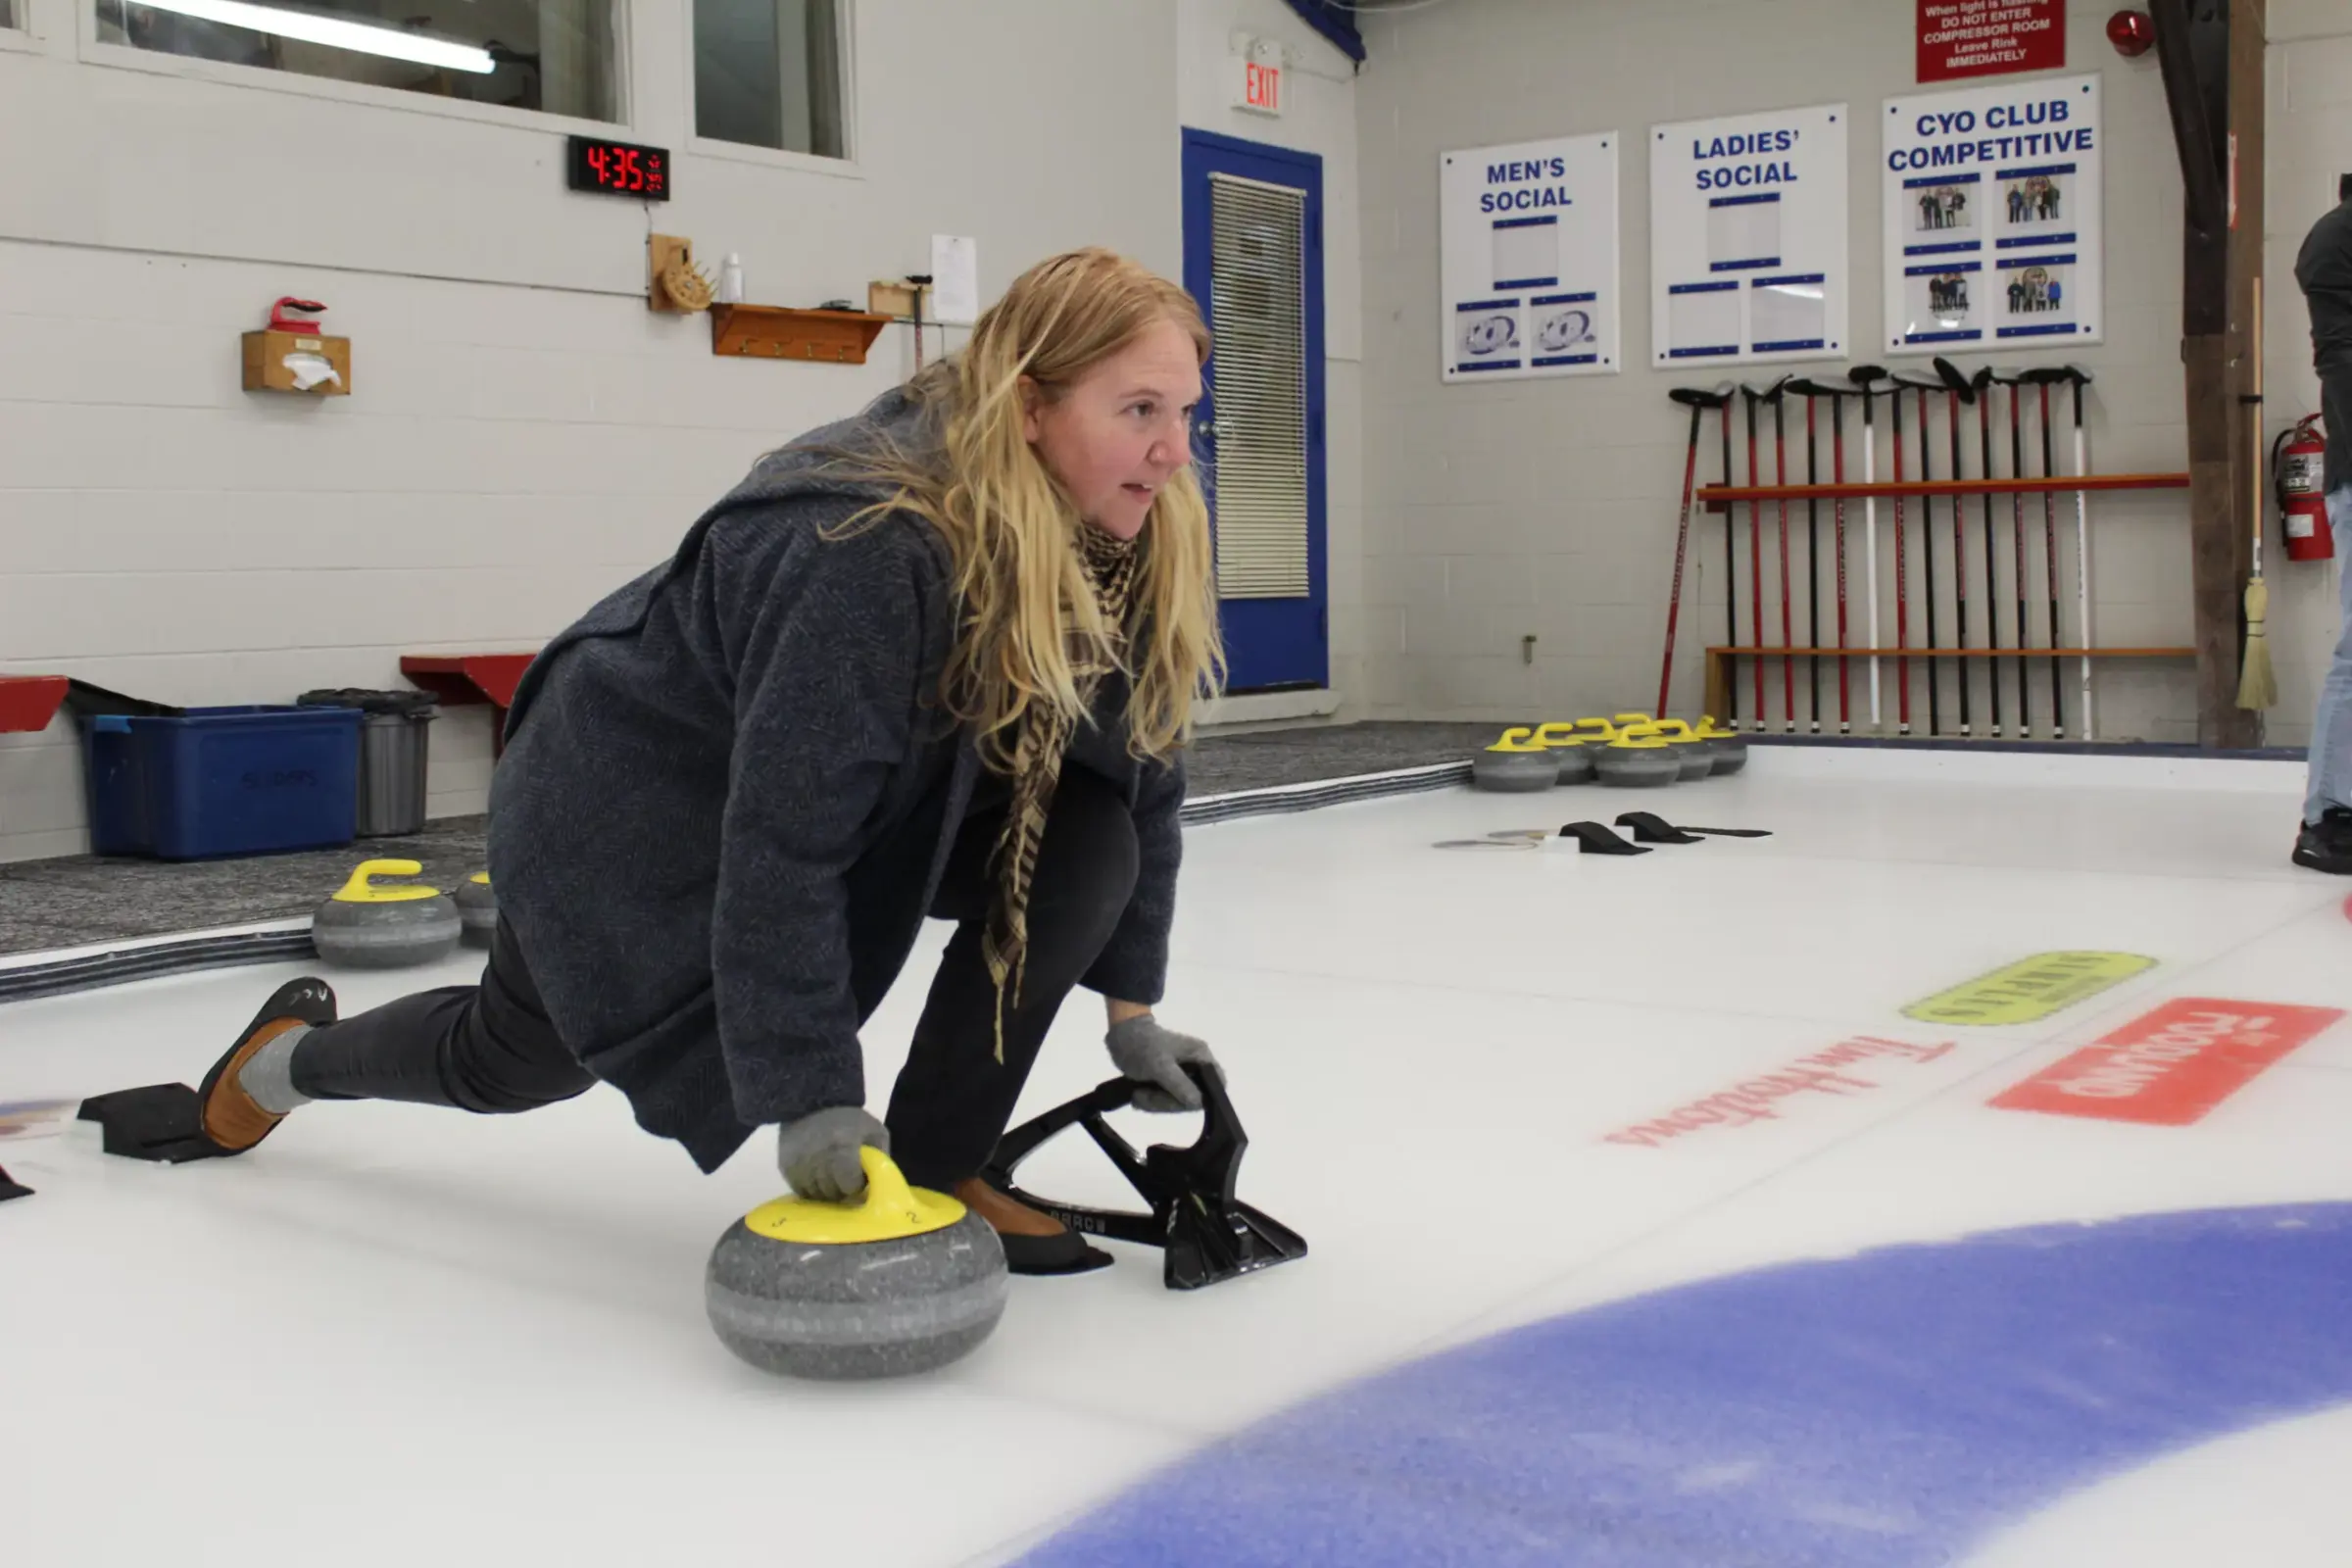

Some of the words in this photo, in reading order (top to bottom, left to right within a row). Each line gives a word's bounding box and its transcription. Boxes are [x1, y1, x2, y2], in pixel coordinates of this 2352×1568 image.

[1926, 6, 1957, 17] When
[1960, 1, 1985, 14] light
[1941, 16, 1959, 28] DO
[1962, 13, 1986, 25] NOT
[1989, 7, 2031, 22] ENTER
[1924, 24, 2008, 44] COMPRESSOR
[2012, 19, 2050, 33] ROOM
[1946, 48, 2027, 69] IMMEDIATELY
[1954, 42, 1987, 54] Leave
[1991, 37, 2017, 49] Rink
[1247, 62, 1278, 109] EXIT
[1917, 110, 1976, 137] CYO
[1985, 100, 2069, 129] CLUB
[1693, 129, 1799, 161] LADIES'
[1887, 128, 2093, 172] COMPETITIVE
[588, 146, 643, 191] 4:35
[1488, 157, 1565, 184] MEN'S
[1695, 162, 1798, 190] SOCIAL
[1480, 186, 1573, 213] SOCIAL
